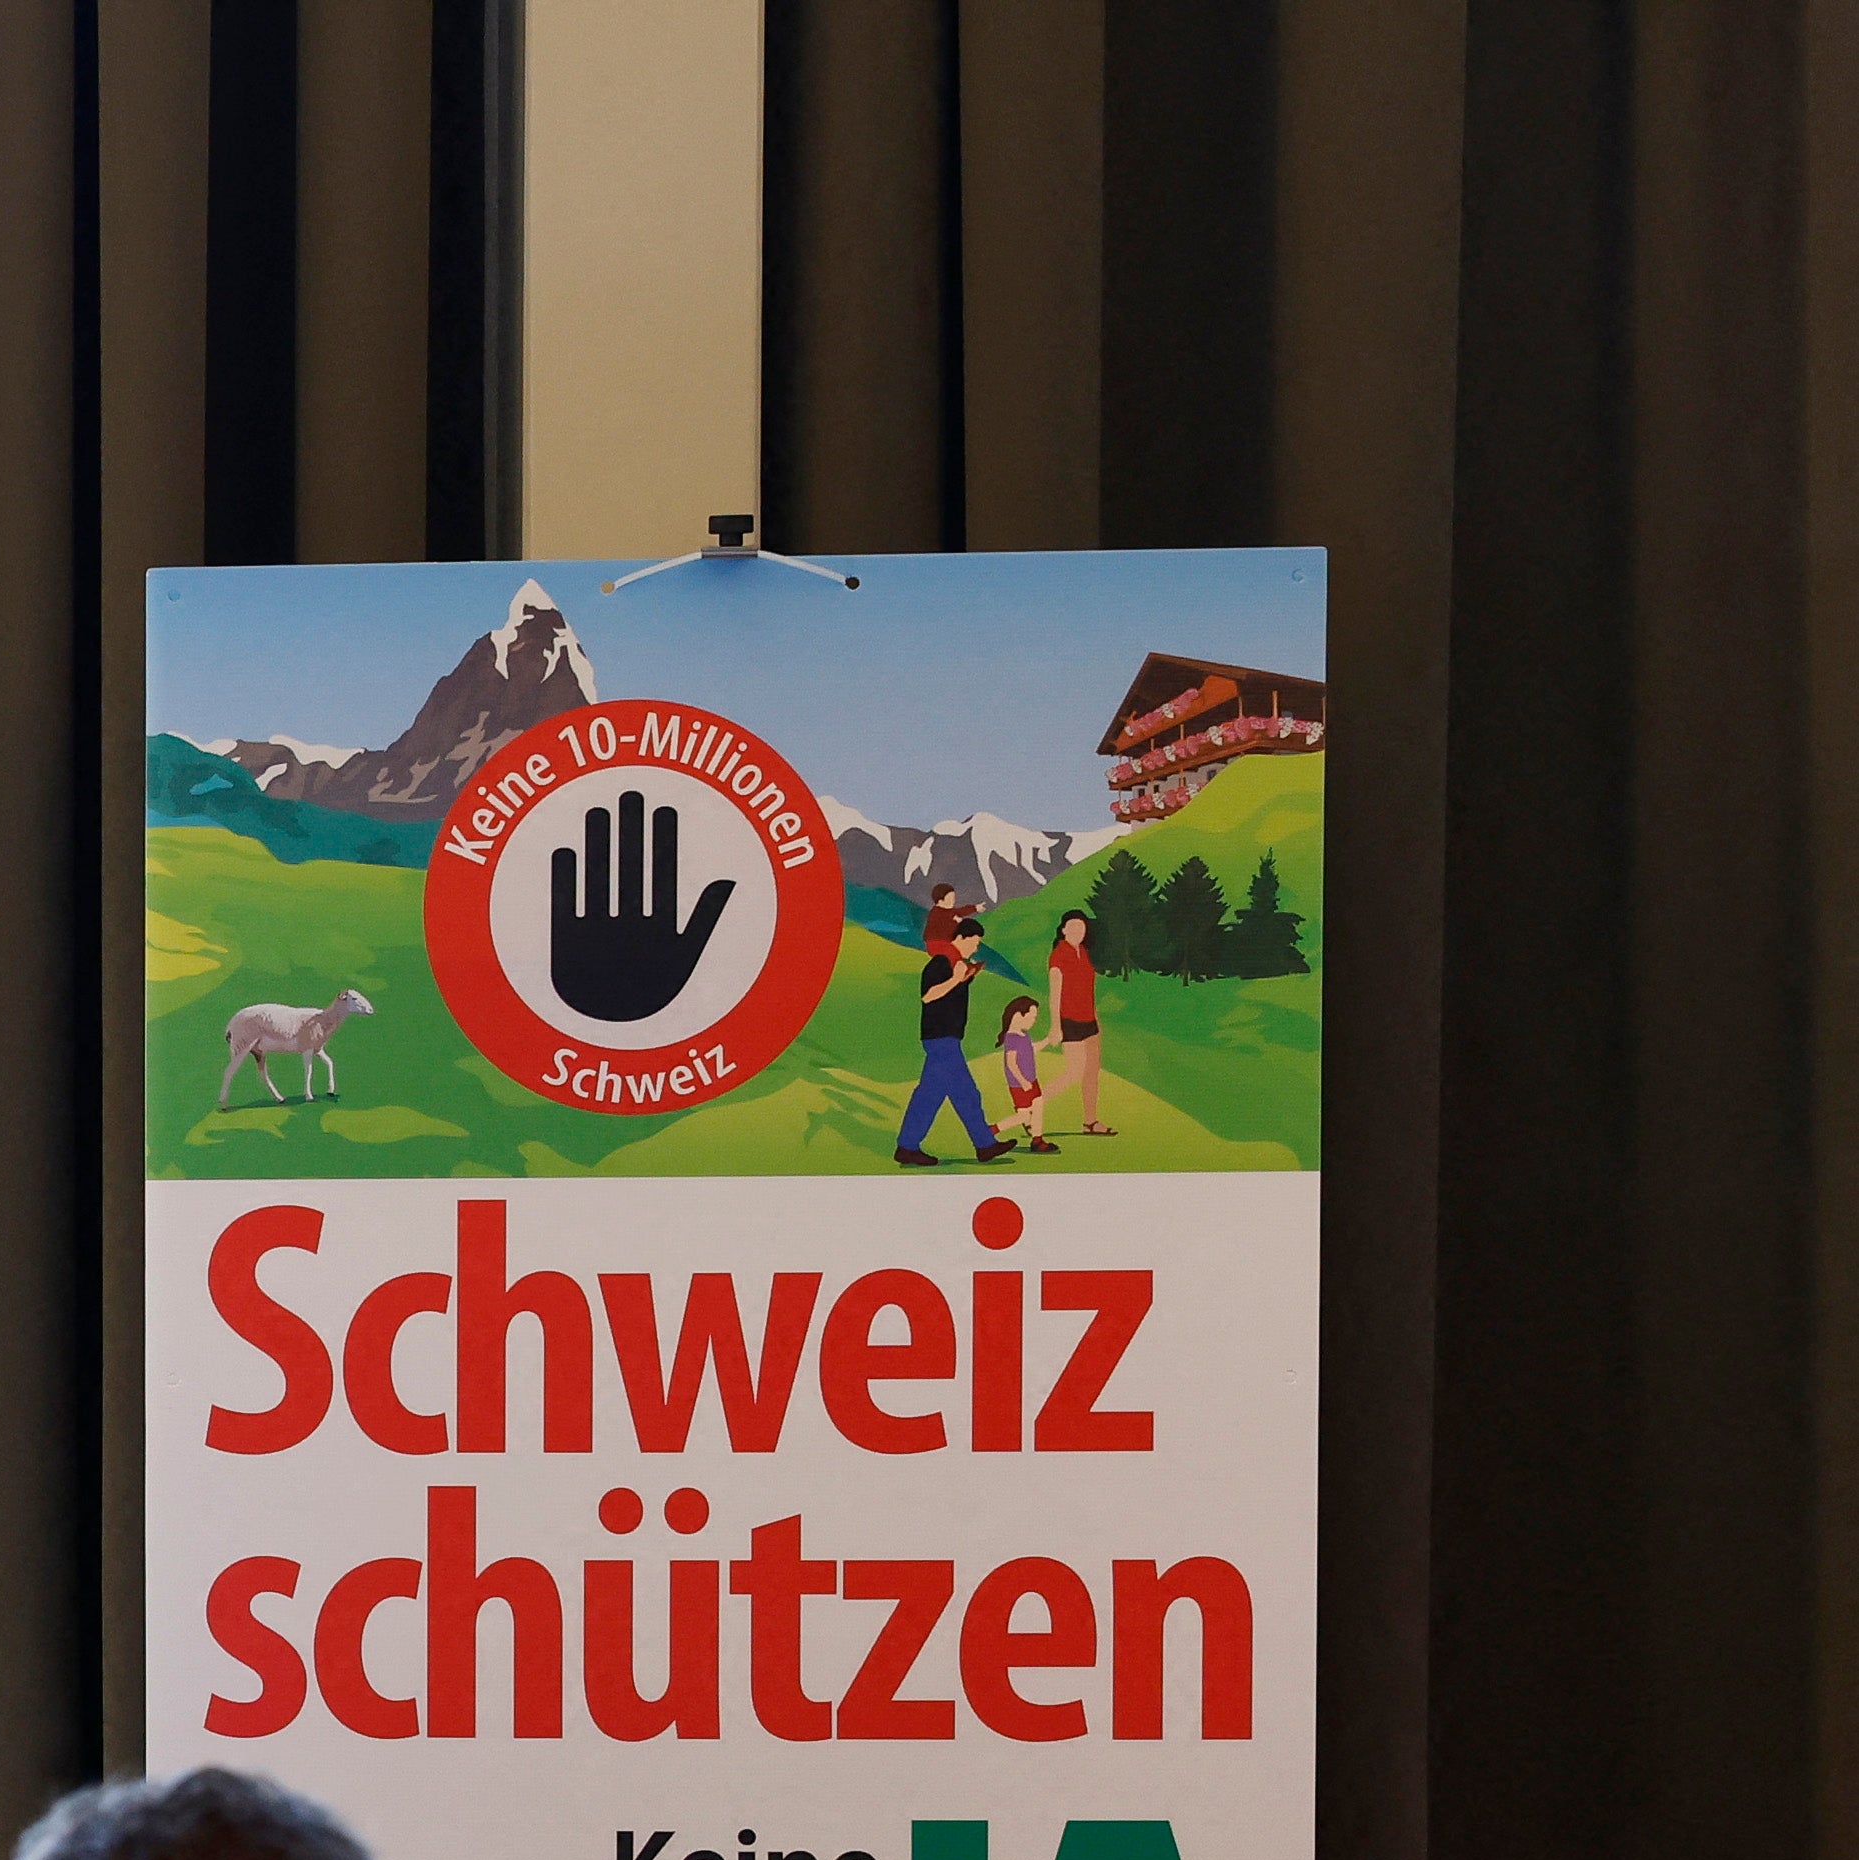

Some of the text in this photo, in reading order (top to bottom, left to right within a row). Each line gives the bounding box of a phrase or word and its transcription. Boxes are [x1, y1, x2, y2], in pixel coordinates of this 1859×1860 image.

[443, 711, 816, 870] Keine 10-Millionen
[542, 1043, 737, 1105] Schweiz
[205, 1196, 1154, 1456] Schweiz
[204, 1485, 1253, 1743] schützen
